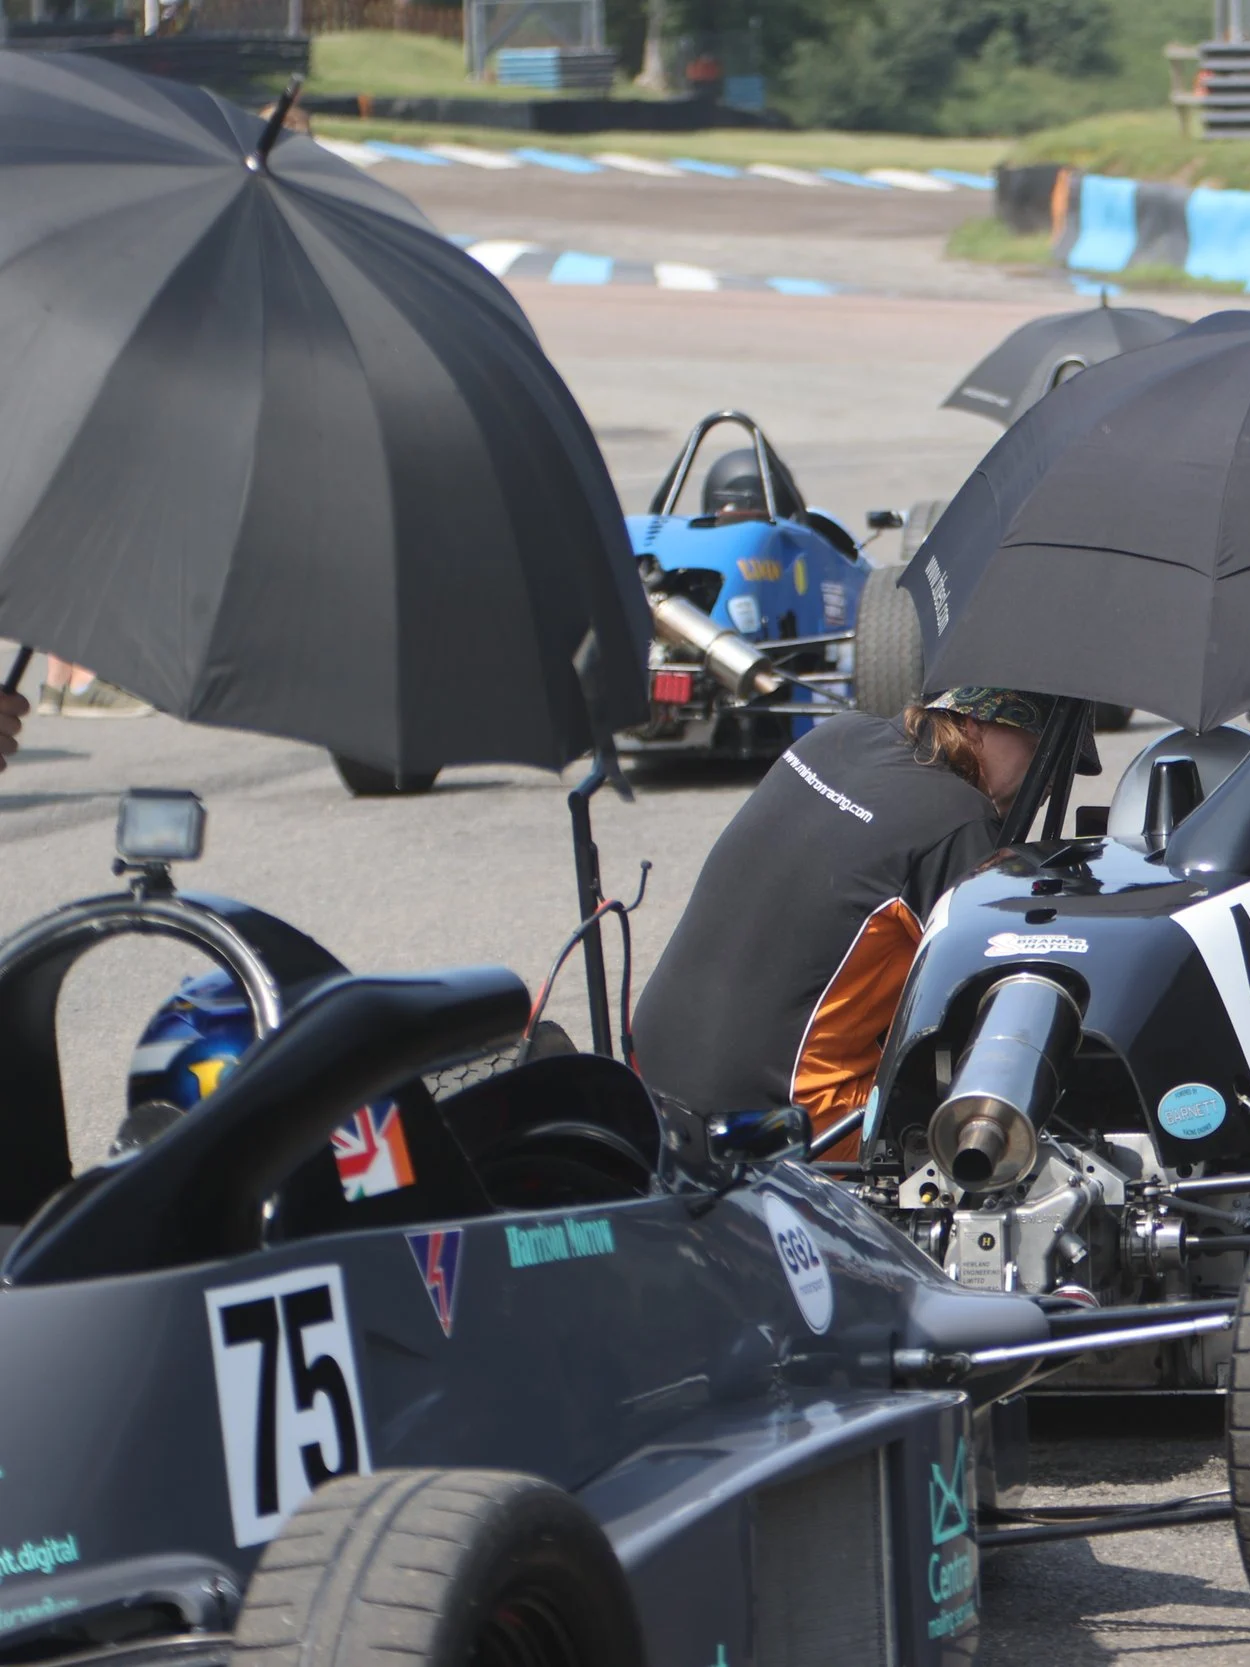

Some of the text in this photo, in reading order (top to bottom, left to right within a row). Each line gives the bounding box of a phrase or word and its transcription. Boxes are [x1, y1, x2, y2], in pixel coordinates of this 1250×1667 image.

[1164, 1100, 1217, 1126] BARNETT
[778, 1228, 819, 1275] GG2
[982, 1237, 991, 1247] H
[218, 1284, 360, 1518] 75
